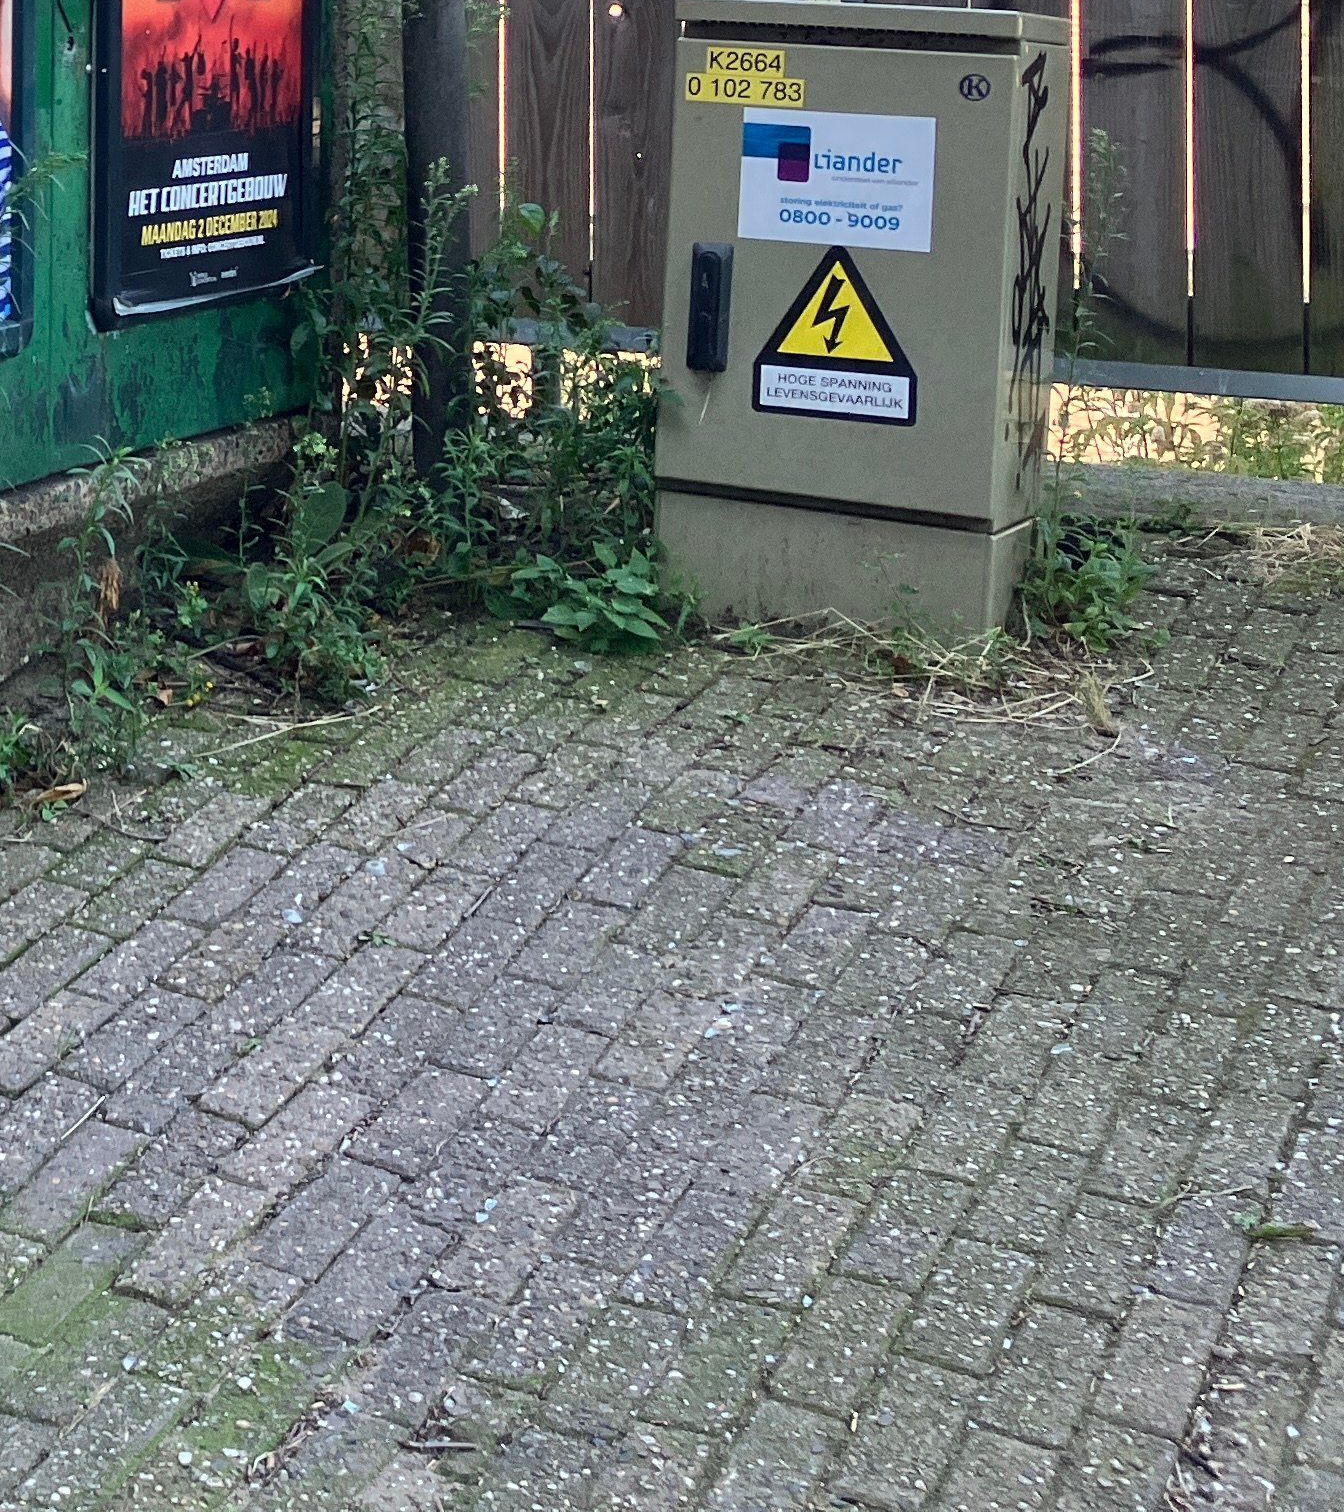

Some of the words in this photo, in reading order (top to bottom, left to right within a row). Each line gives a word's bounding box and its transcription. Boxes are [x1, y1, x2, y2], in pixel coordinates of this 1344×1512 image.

[710, 51, 782, 72] K2664
[688, 76, 701, 96] 0
[711, 78, 751, 99] 102
[760, 80, 802, 102] 783
[172, 152, 249, 179] AMSTERDAM
[128, 188, 160, 217] HET
[161, 173, 288, 212] CONCERTGEBOUW
[780, 197, 812, 207] storing
[869, 202, 879, 210] of
[881, 204, 904, 213] gas?
[141, 218, 197, 246] MAANDAG
[197, 218, 205, 238] 2
[205, 211, 257, 237] DECEMBER
[779, 208, 831, 226] 0800
[847, 212, 900, 230] 9009
[777, 373, 817, 386] HOGE
[820, 376, 892, 393] SPANNING
[766, 387, 904, 410] LEVENSGEVAARLIJK
